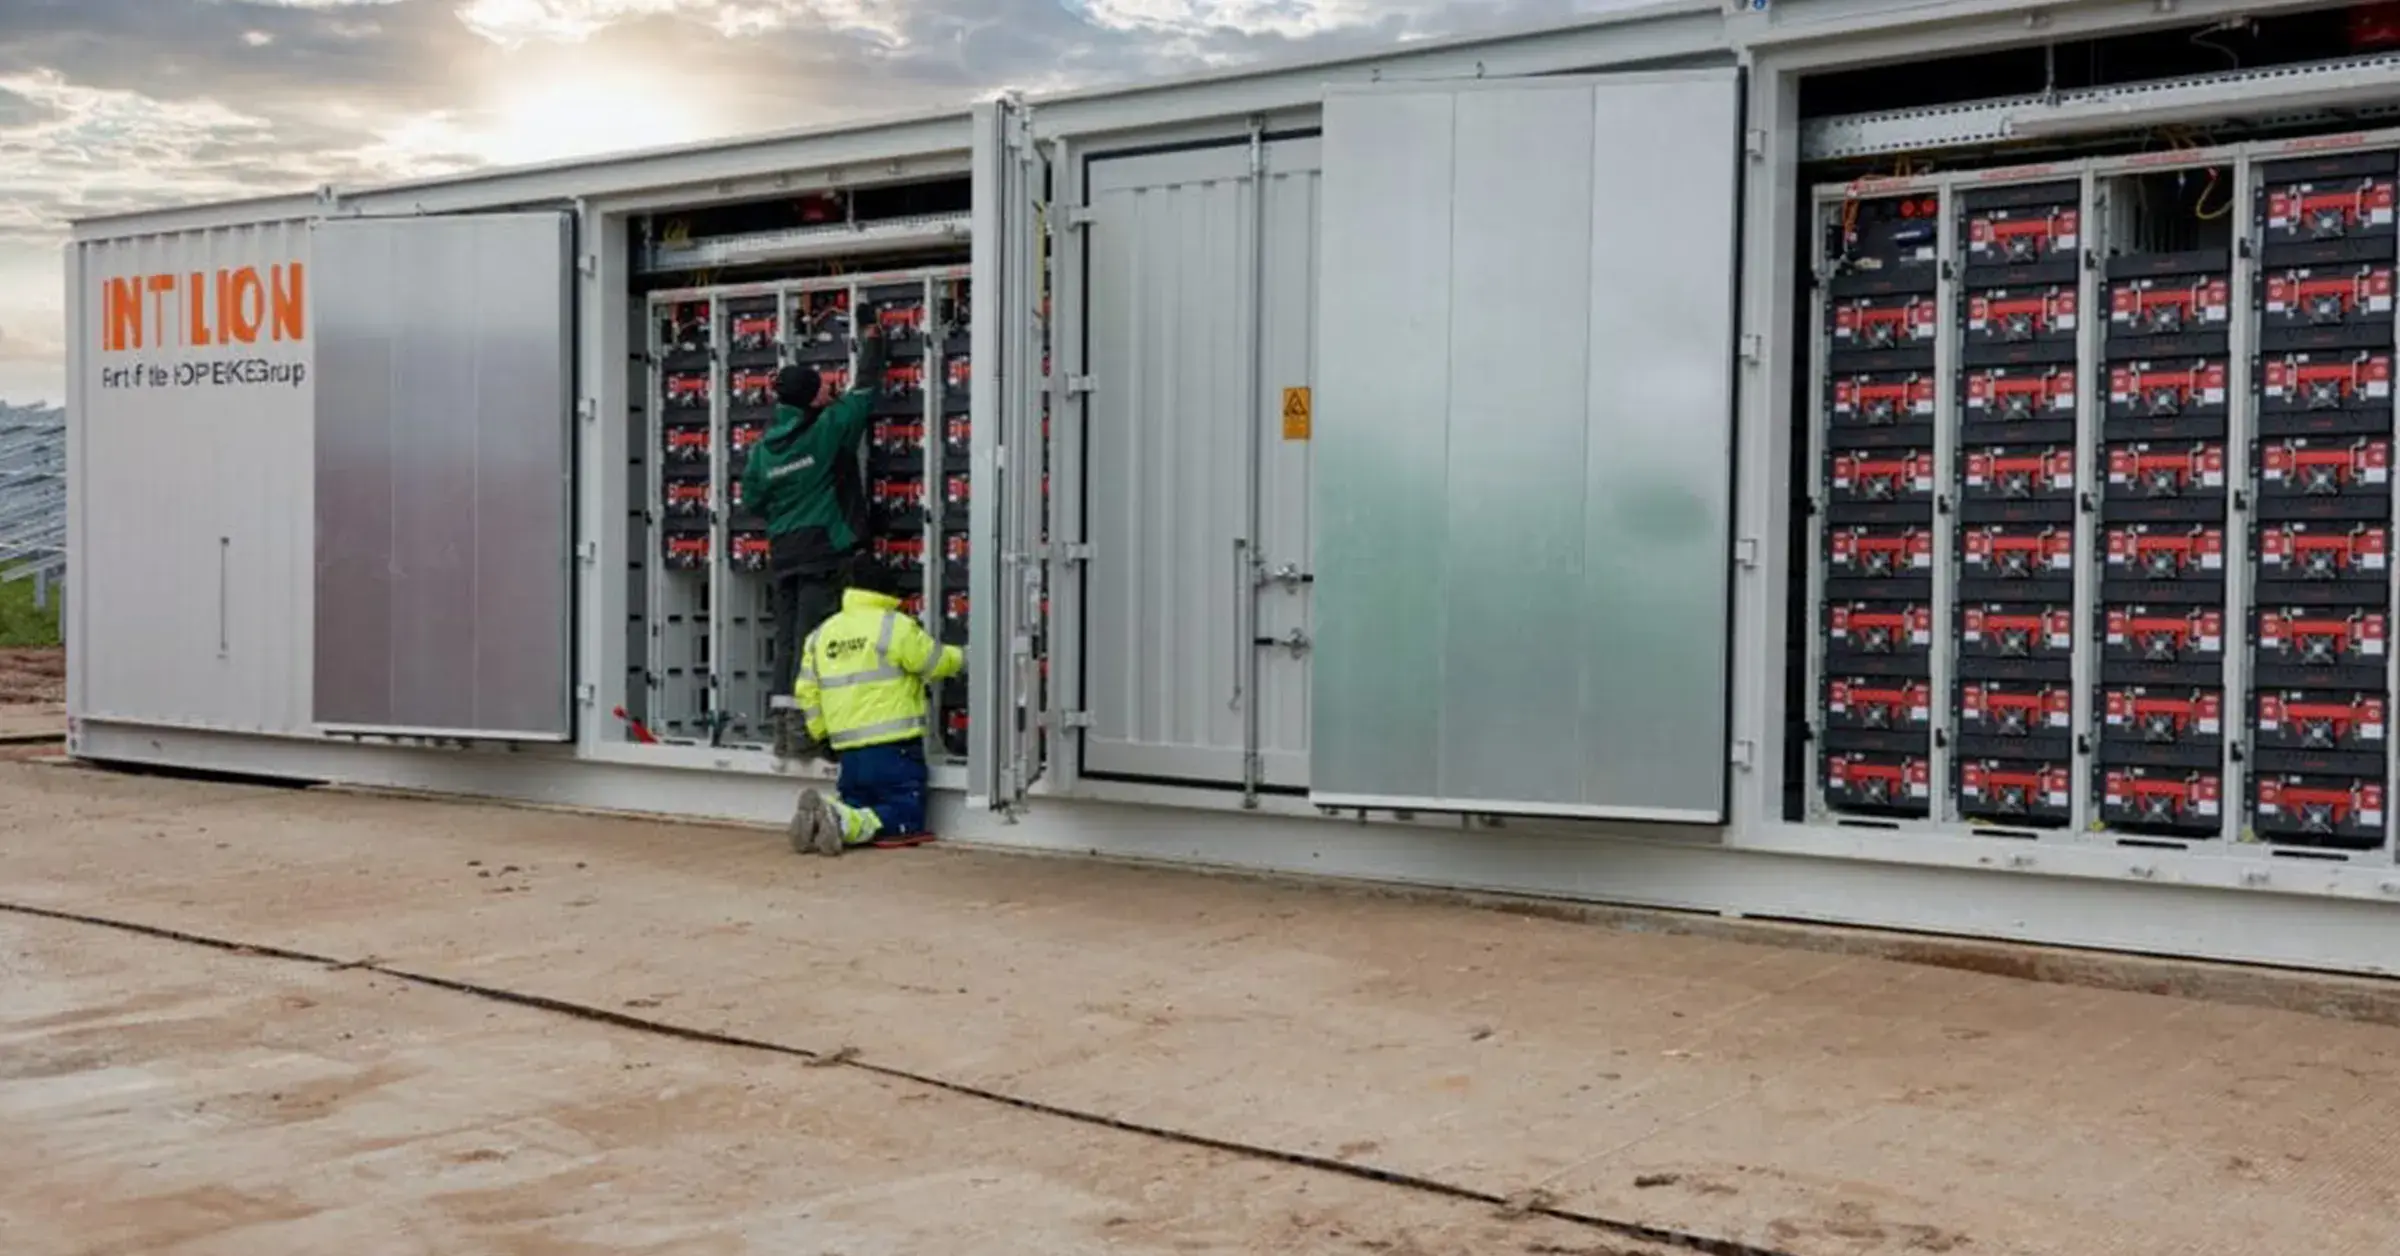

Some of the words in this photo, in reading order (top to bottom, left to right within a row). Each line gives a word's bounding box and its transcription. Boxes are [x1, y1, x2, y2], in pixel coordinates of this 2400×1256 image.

[102, 366, 129, 388] Prt
[149, 363, 168, 387] te
[254, 358, 305, 387] Grup
